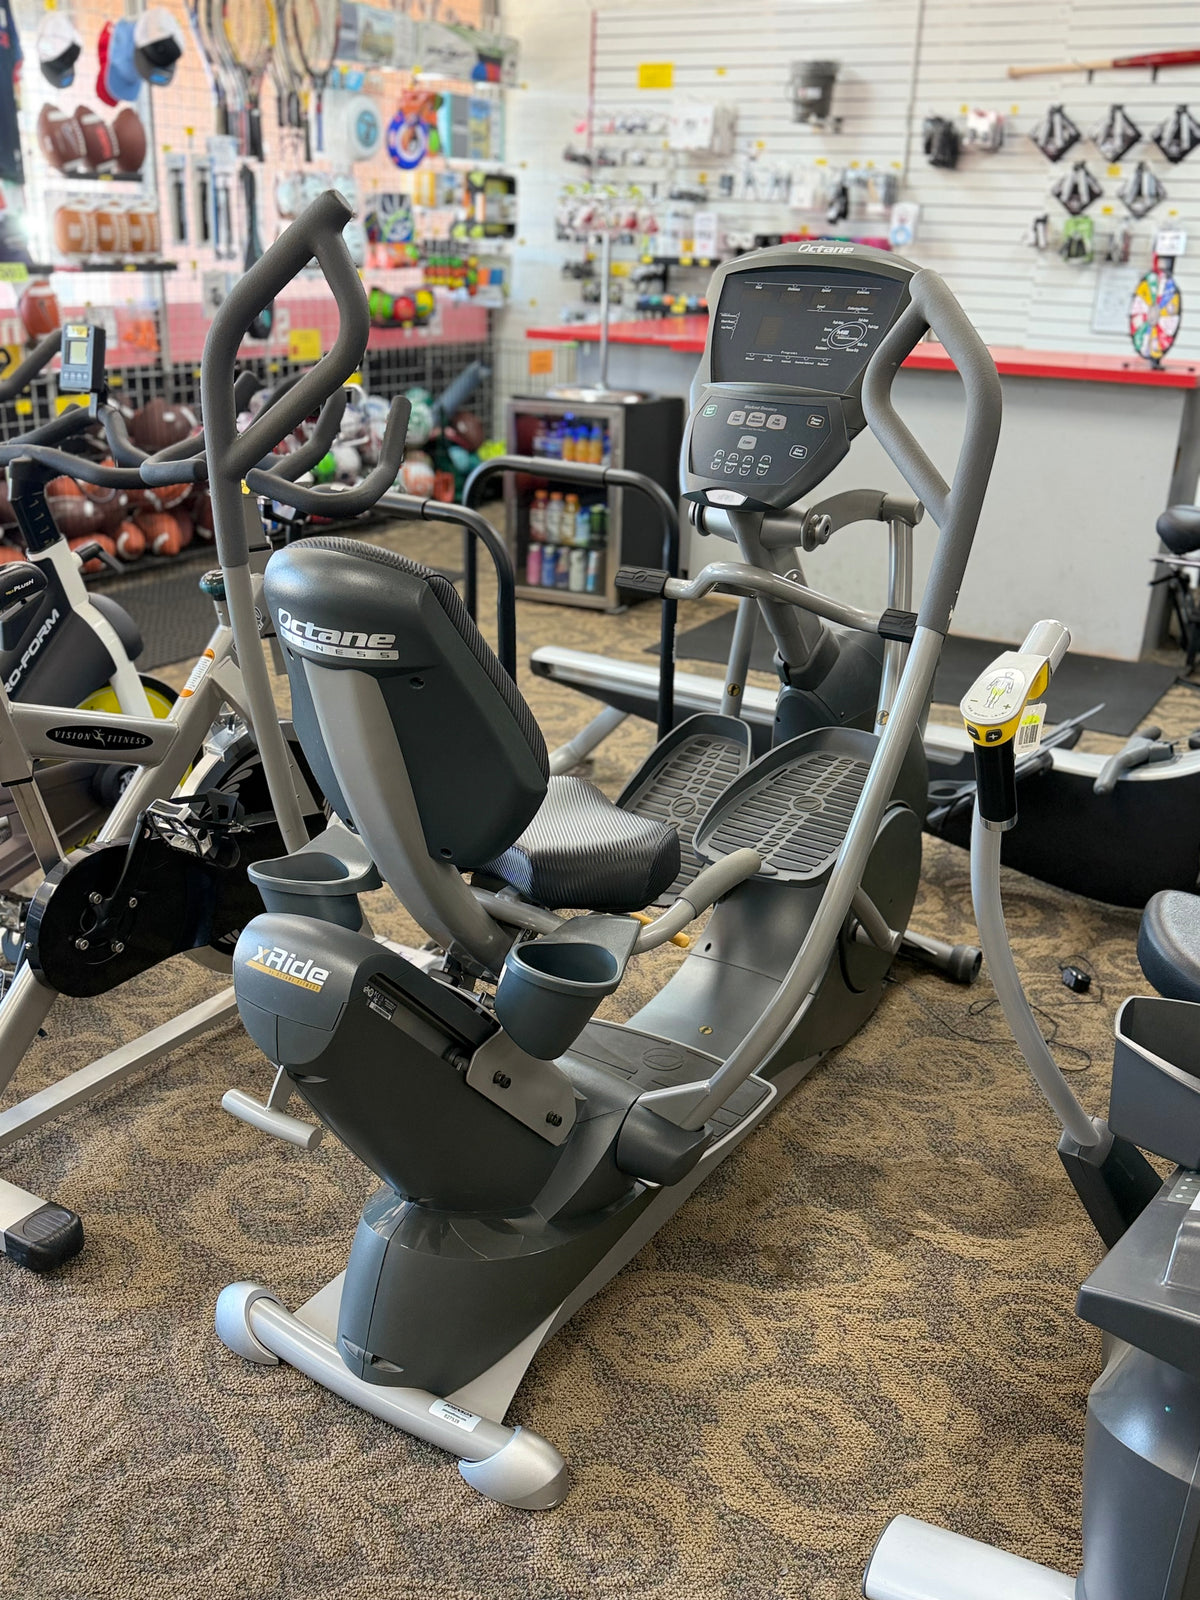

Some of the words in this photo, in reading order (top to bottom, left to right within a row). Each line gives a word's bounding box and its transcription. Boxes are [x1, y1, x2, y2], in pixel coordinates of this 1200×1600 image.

[798, 243, 855, 255] Octane
[278, 607, 396, 649] Octane
[3, 608, 60, 694] RO-FORM
[54, 729, 92, 741] VISION
[106, 733, 147, 746] FITNESS
[251, 945, 329, 986] xRide
